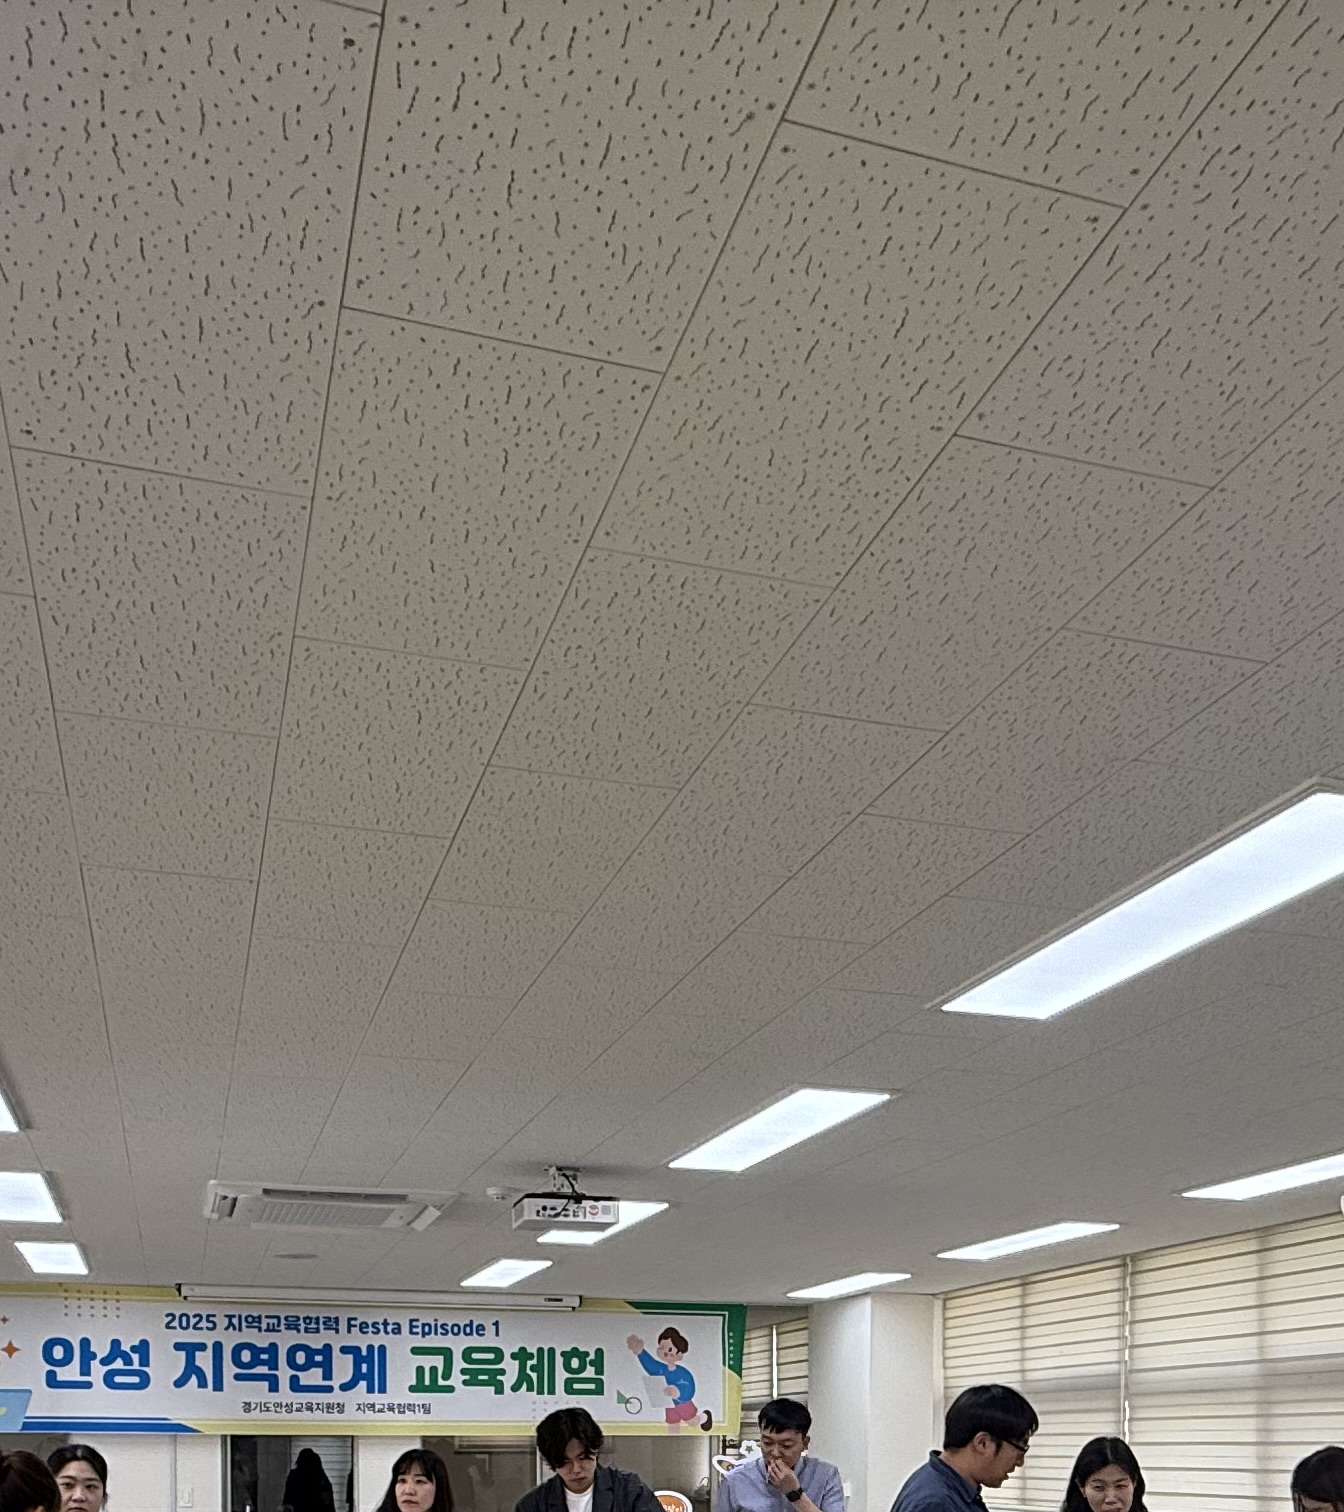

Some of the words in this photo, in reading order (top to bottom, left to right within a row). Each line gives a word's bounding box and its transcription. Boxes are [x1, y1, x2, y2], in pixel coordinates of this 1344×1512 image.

[164, 1312, 218, 1332] 2025
[223, 1313, 341, 1335] 지역교육협력
[346, 1317, 402, 1336] Festa
[408, 1318, 486, 1339] Episode
[491, 1320, 500, 1337] 1
[41, 1336, 151, 1391] 안성
[172, 1340, 388, 1396] 지역연계
[408, 1345, 605, 1396] 교육체험
[241, 1401, 346, 1415] 경기도안성교육지원청
[355, 1401, 432, 1415] 지역교육협력1팀
